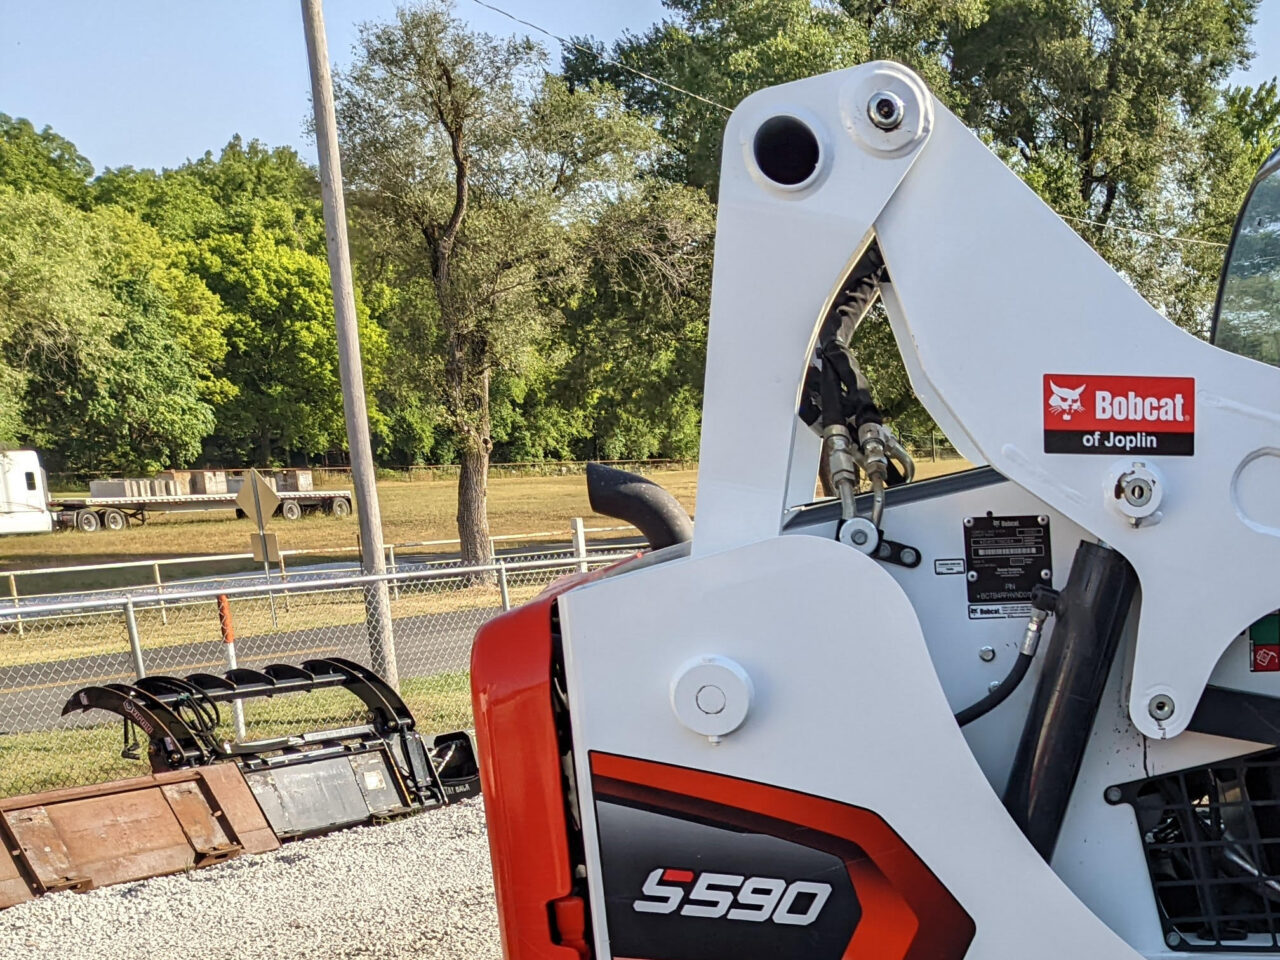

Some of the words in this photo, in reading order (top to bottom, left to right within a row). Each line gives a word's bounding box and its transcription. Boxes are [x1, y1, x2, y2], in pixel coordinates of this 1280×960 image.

[1095, 391, 1184, 421] Bobcat
[1083, 431, 1100, 446] of
[1104, 431, 1157, 450] Joplin
[633, 868, 832, 926] S590
